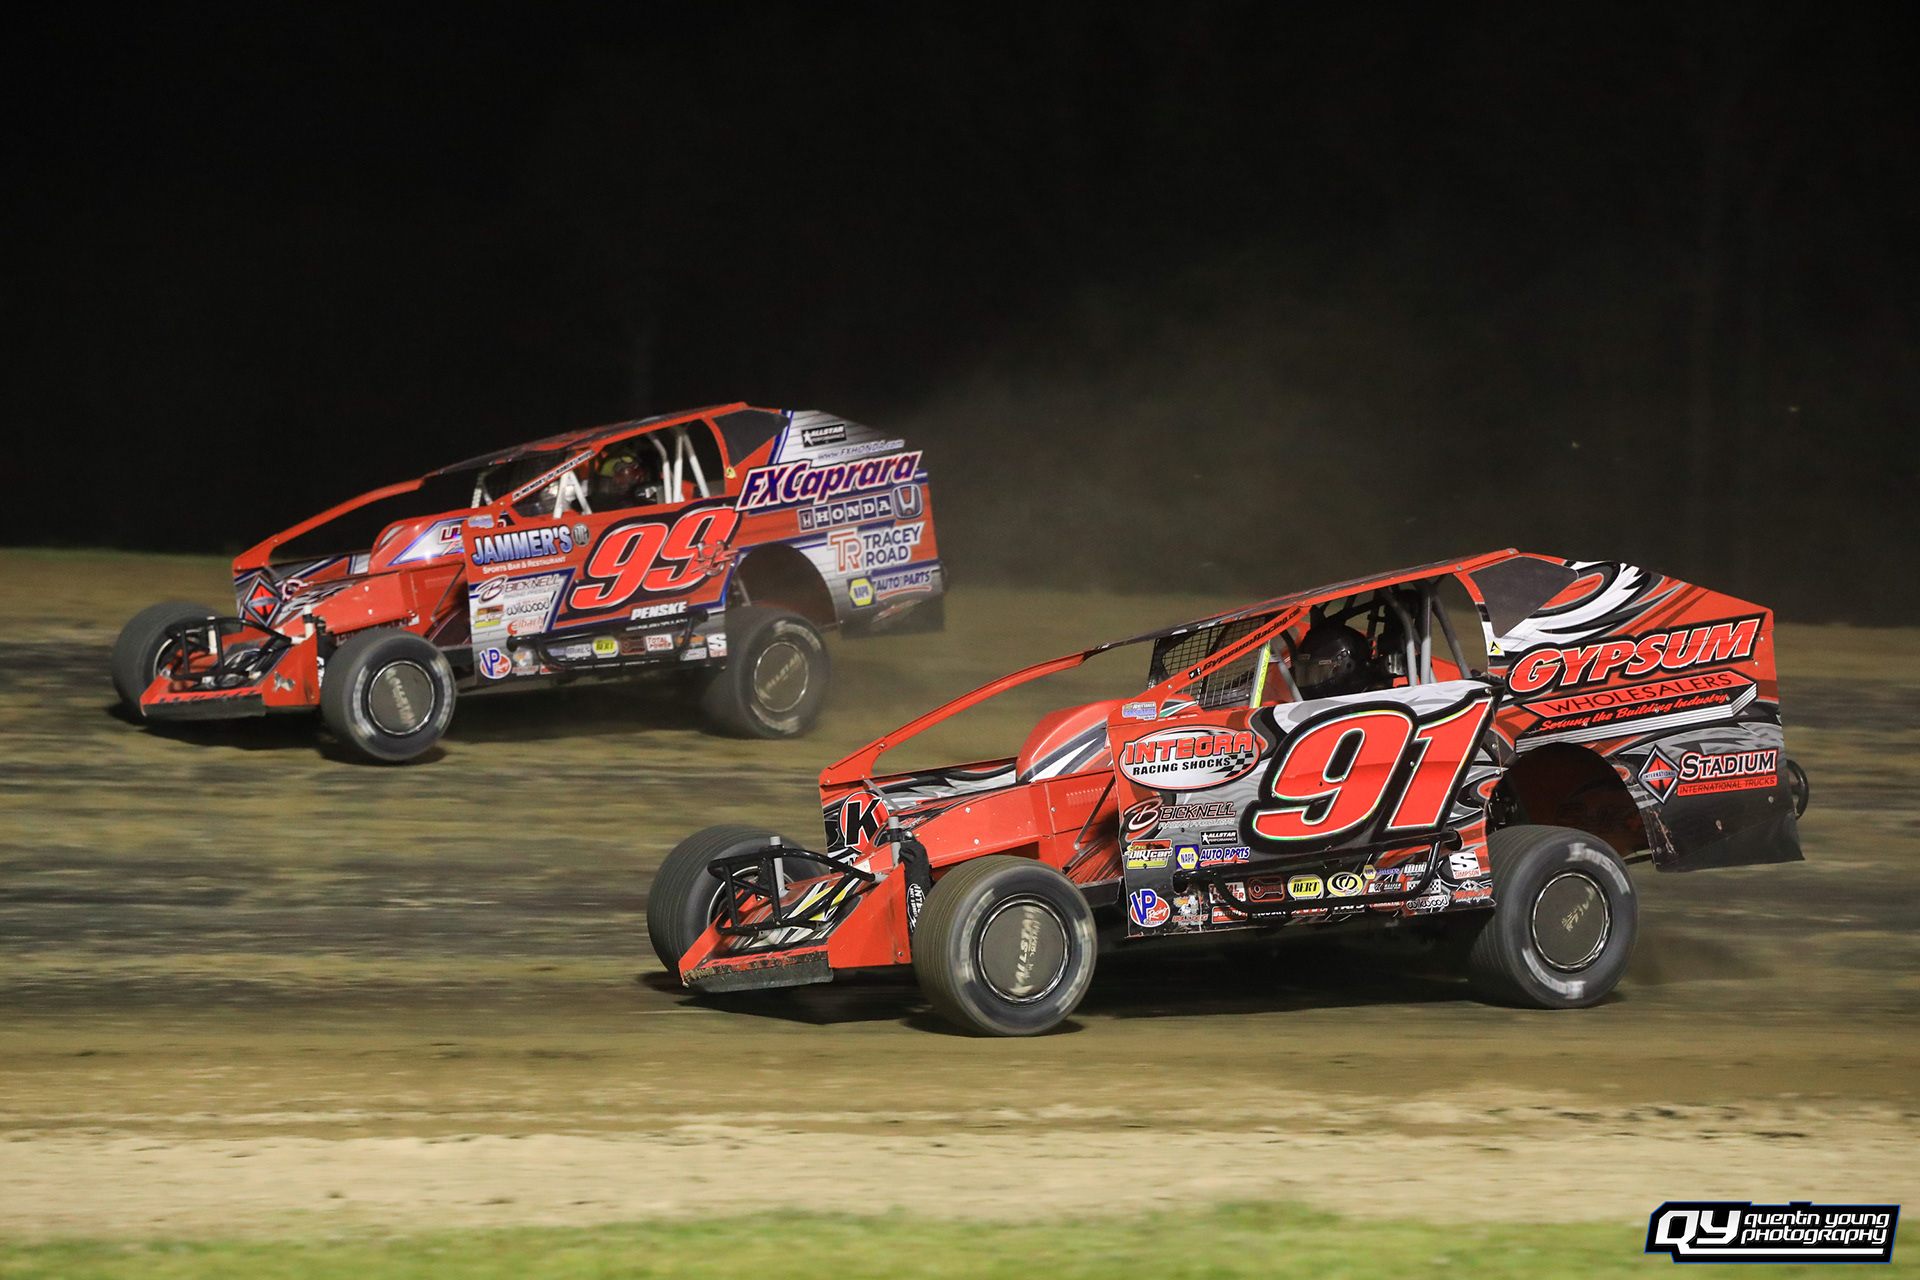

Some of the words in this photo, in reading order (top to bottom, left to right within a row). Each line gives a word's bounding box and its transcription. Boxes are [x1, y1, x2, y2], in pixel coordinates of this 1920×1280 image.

[811, 426, 843, 436] ALLSTAR
[816, 501, 892, 523] HONDA
[472, 525, 573, 565] JAMMER'S
[863, 526, 921, 549] TRACEY
[570, 506, 739, 609] 99
[866, 546, 909, 567] ROAD
[504, 574, 560, 593] BICKNELL
[876, 577, 900, 591] AUTO
[903, 571, 930, 585] PARTS
[631, 602, 688, 620] PENSKE
[481, 649, 500, 677] VP
[1509, 619, 1761, 692] GYPSUM
[1546, 673, 1732, 713] WHOLESALERS
[1592, 712, 1613, 723] the
[1616, 702, 1672, 719] Building
[1674, 692, 1728, 709] Industry
[1125, 732, 1254, 764] INTEGRA
[1132, 762, 1178, 776] RACING
[1182, 757, 1231, 771] SHOCKS
[1255, 697, 1493, 839] 91
[1681, 751, 1776, 779] STADIUM
[1680, 780, 1742, 794] INTERNATIONAL
[1744, 777, 1775, 788] TRUCKS
[1160, 802, 1237, 821] BICKNELL
[845, 798, 882, 847] K
[1181, 853, 1195, 863] NAPA
[1201, 848, 1222, 860] AUTO
[1225, 847, 1250, 859] PARTS
[1454, 870, 1480, 878] SIMPSON
[1293, 882, 1320, 893] BERT
[1130, 889, 1157, 924] VP
[1406, 895, 1449, 910] wilwood
